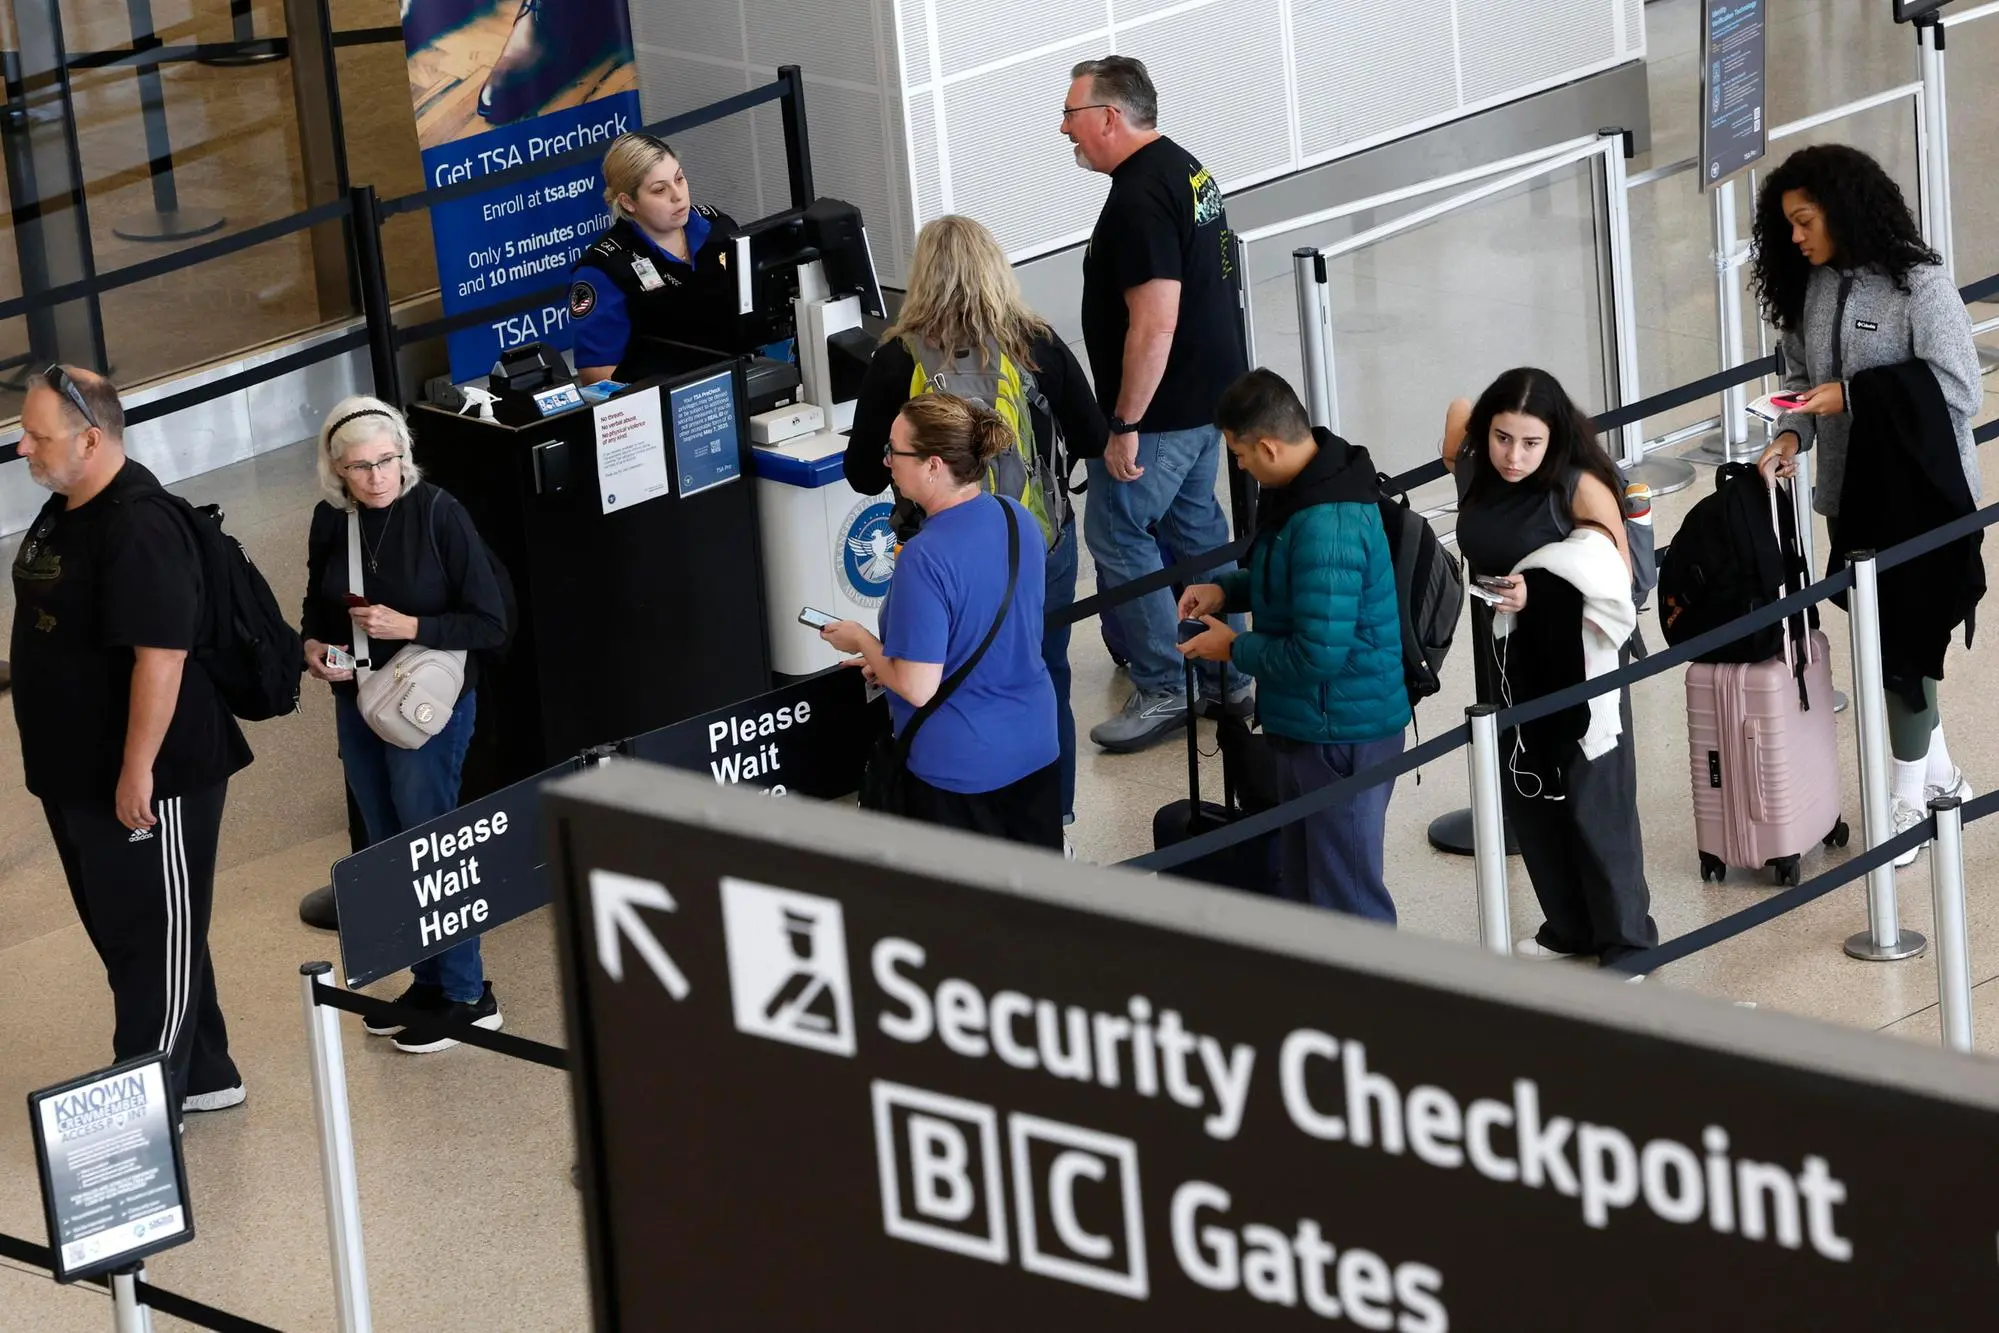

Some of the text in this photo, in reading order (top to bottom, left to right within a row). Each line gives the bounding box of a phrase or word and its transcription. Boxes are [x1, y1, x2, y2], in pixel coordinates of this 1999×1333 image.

[435, 112, 627, 188] Get TSA Precheck
[483, 176, 595, 221] Enroll at tsa.gov
[468, 246, 501, 269] Only
[505, 240, 515, 258] 5
[517, 225, 574, 255] minutes
[577, 213, 616, 236] onlin
[458, 274, 485, 297] and
[488, 268, 506, 287] 10
[509, 252, 566, 280] minutes
[568, 246, 581, 263] in
[492, 314, 539, 349] TSA
[708, 701, 811, 753] Please
[710, 742, 781, 787] Wait
[129, 833, 154, 843] adidas
[409, 811, 508, 872] Please
[412, 856, 481, 908] Wait
[419, 898, 489, 947] Here
[54, 1073, 146, 1122] KNOWN
[59, 1094, 146, 1132] CREWMEMBER
[870, 936, 1853, 1264] Security Checkpoint
[62, 1120, 105, 1142] ACCESS
[907, 1113, 1449, 1333] B C Gates
